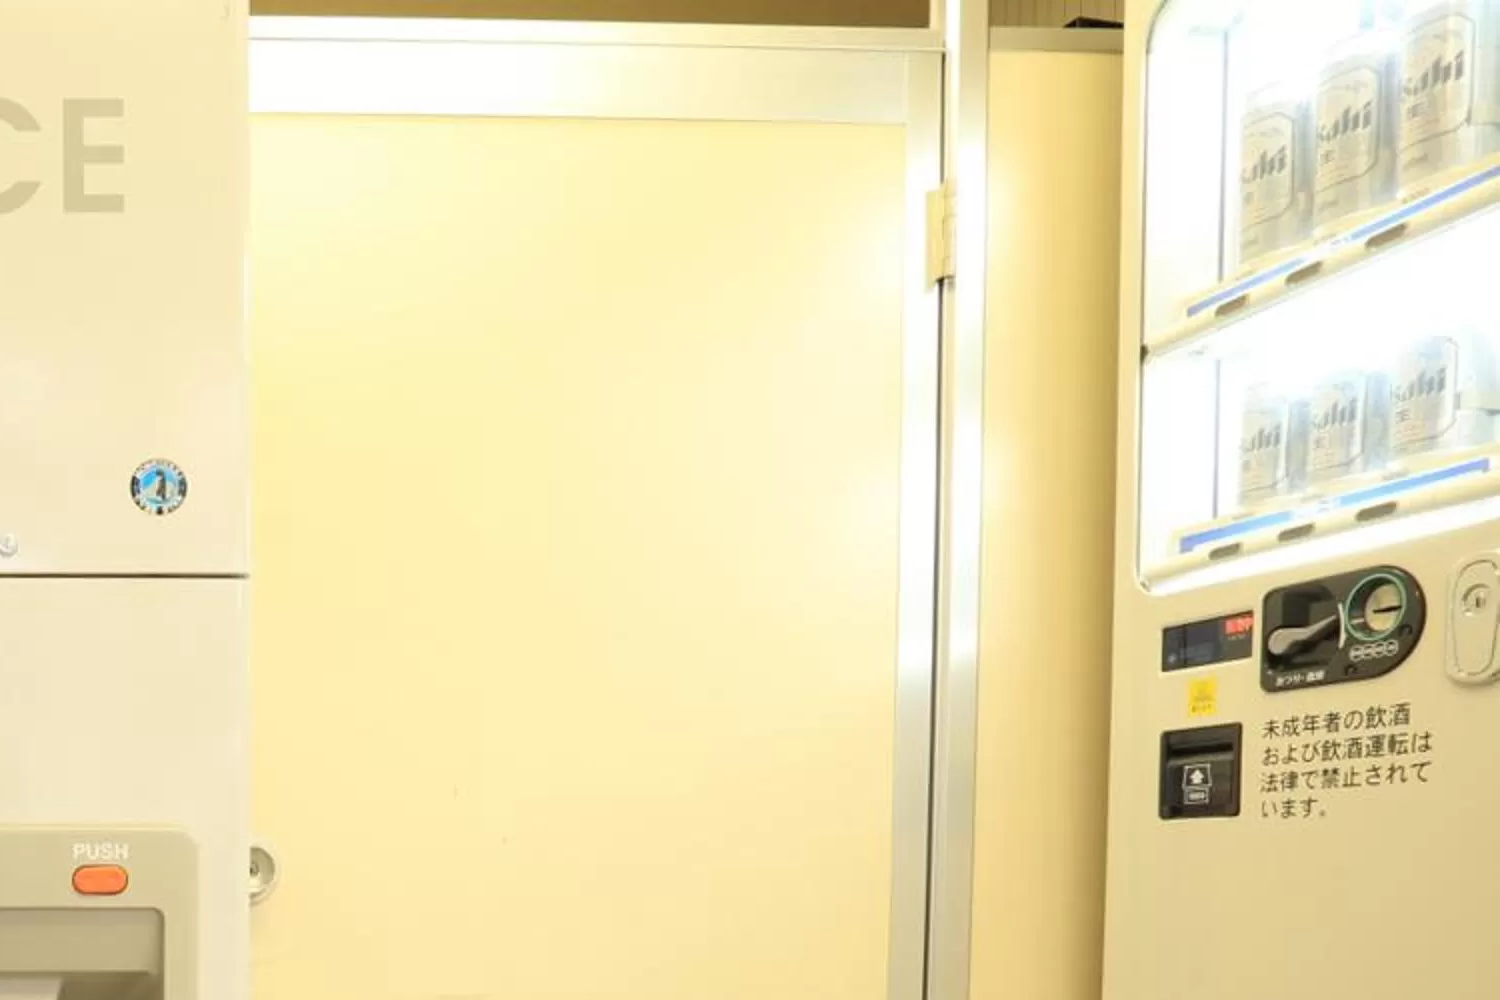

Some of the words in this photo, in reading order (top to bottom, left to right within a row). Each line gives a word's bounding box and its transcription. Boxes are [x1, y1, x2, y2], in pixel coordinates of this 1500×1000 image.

[1403, 50, 1464, 96] sahi
[1262, 701, 1411, 740] 未成年者の飲酒
[1261, 731, 1433, 766] および飲酒運転は
[1260, 760, 1433, 793] 法律で禁止されて
[1261, 796, 1327, 819] います。
[72, 843, 129, 861] PUSH
